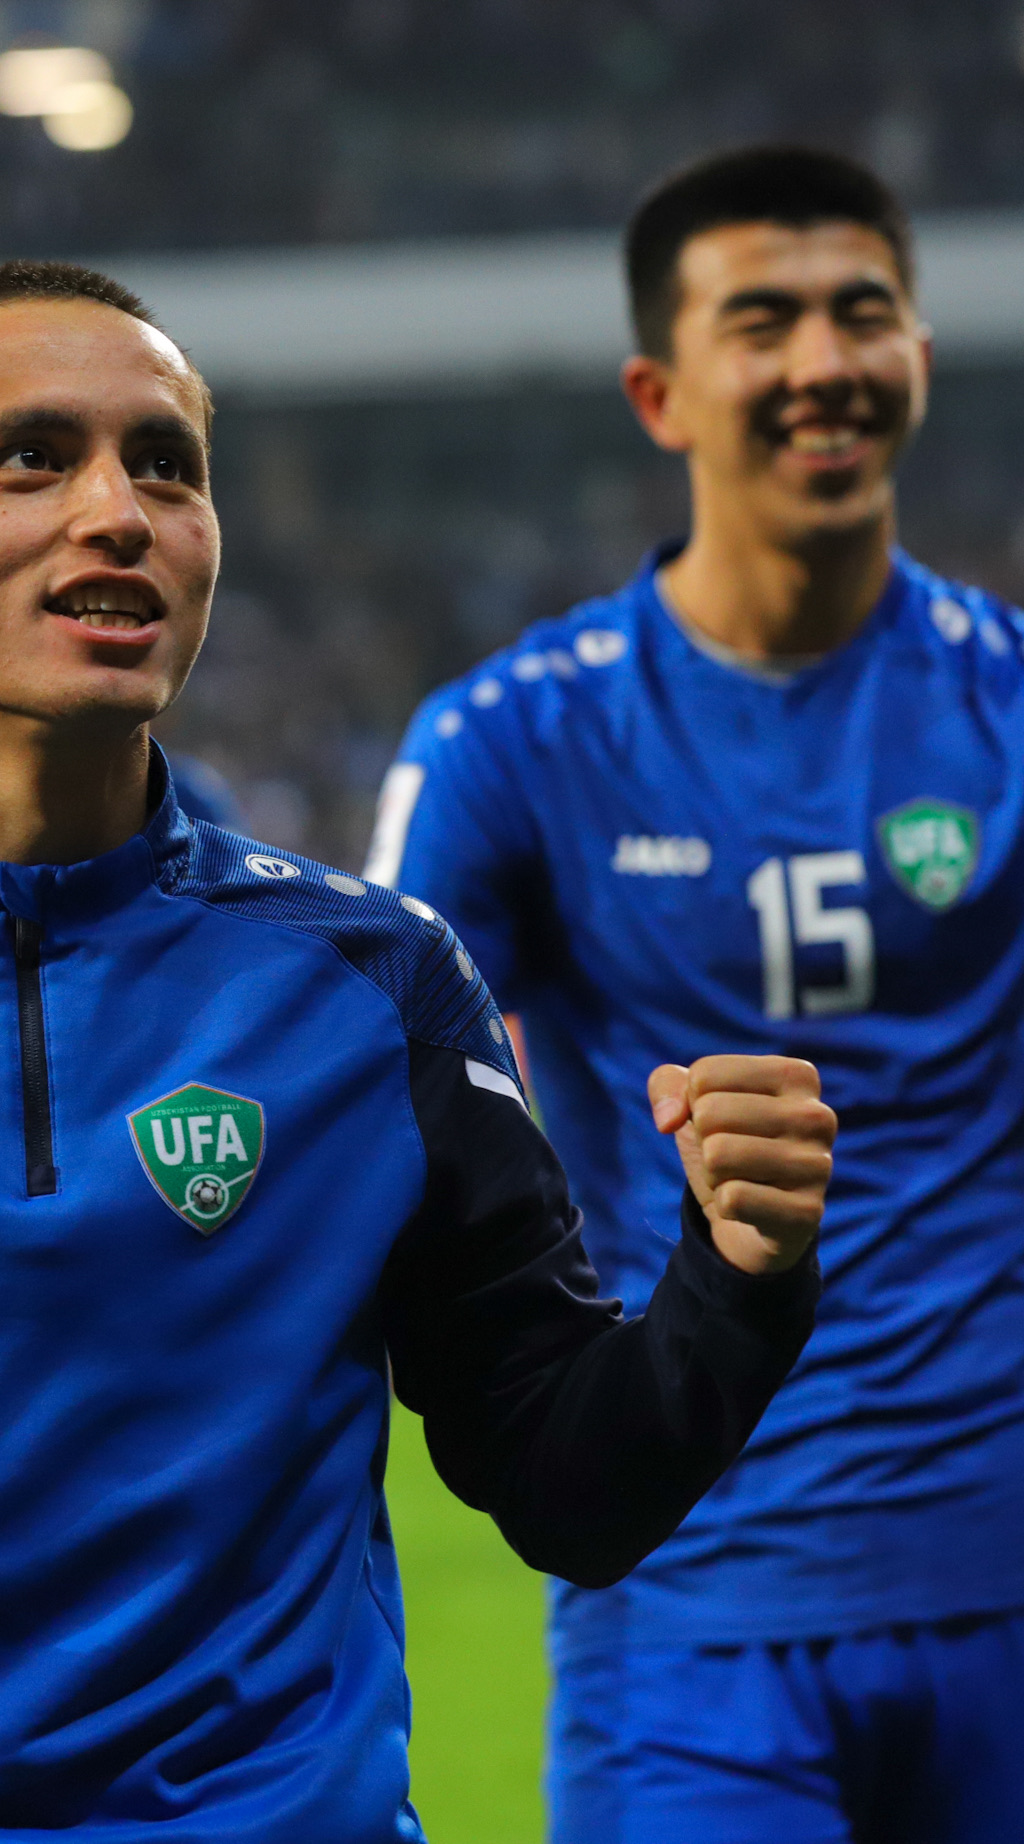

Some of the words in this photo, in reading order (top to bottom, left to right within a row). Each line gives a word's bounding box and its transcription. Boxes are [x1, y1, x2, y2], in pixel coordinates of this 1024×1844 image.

[611, 835, 711, 876] JAKO
[890, 819, 969, 865] UFA
[747, 850, 874, 1020] 15
[150, 1106, 200, 1117] UZBEKISTAN
[150, 1113, 249, 1166] UFA
